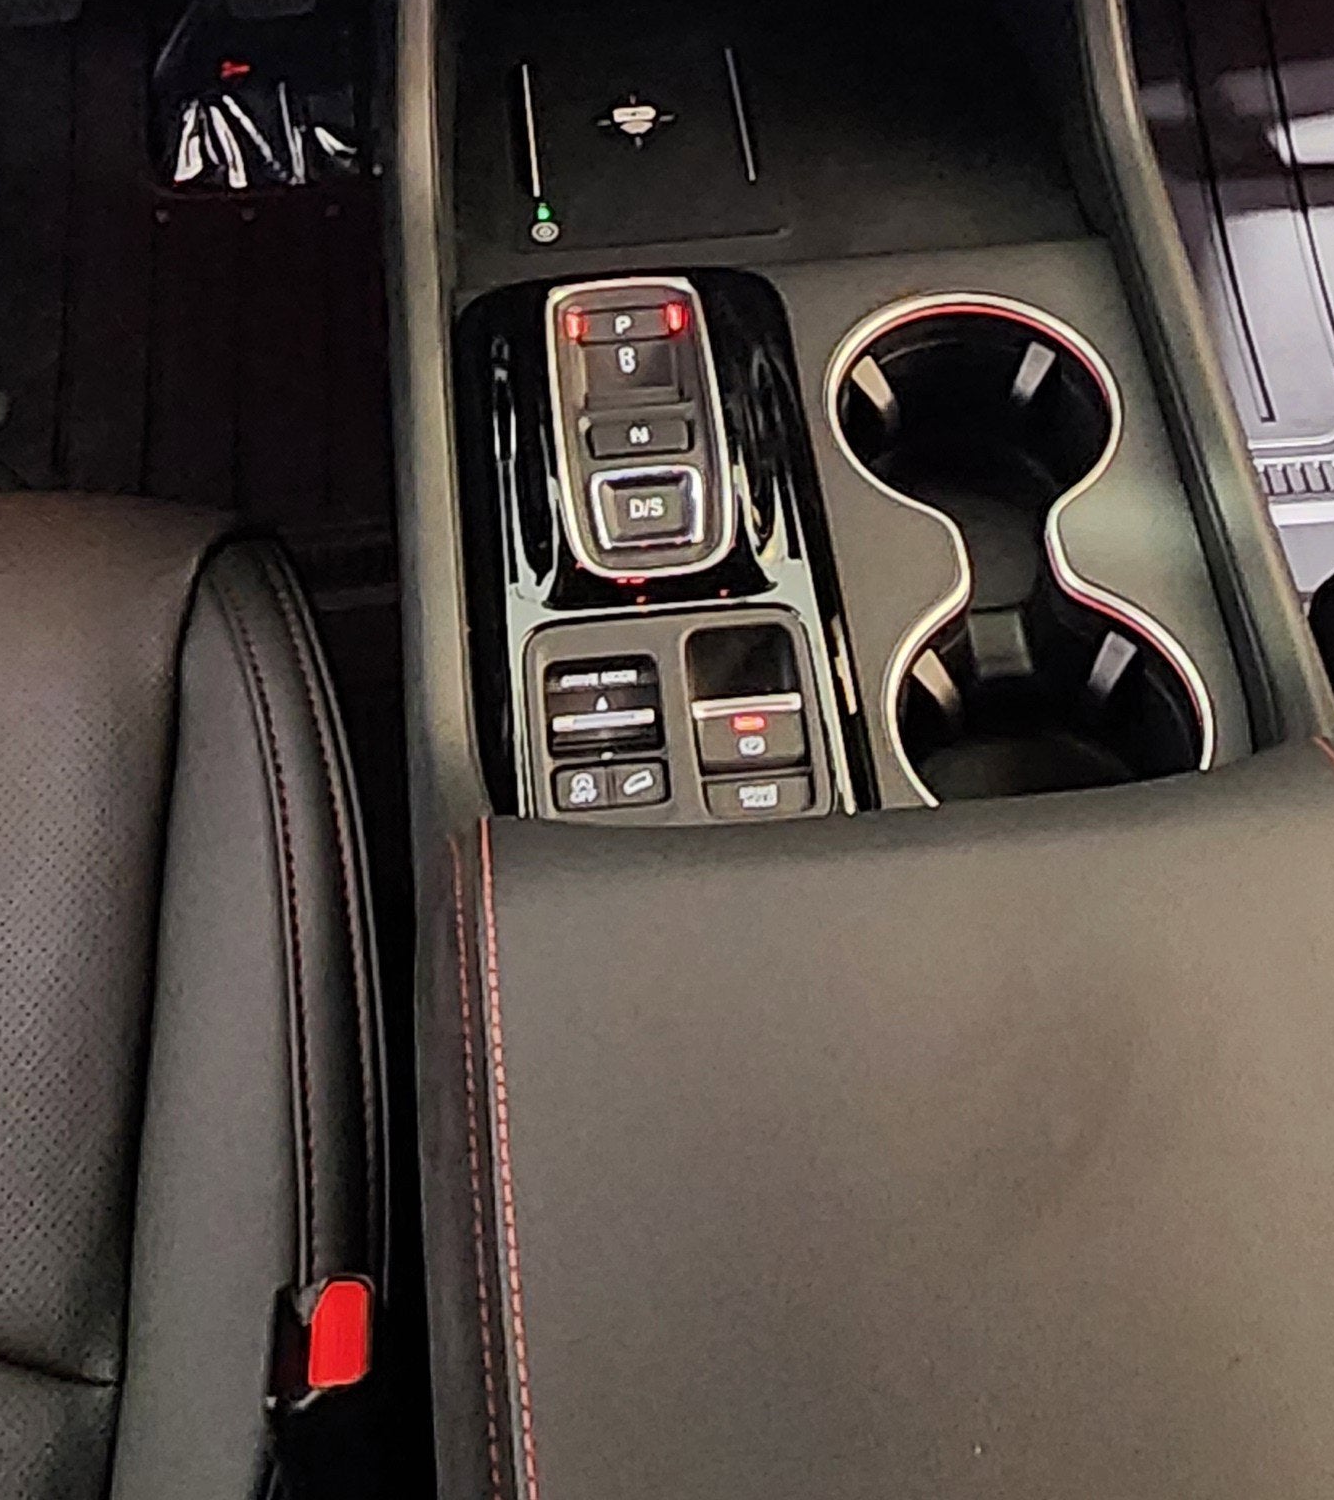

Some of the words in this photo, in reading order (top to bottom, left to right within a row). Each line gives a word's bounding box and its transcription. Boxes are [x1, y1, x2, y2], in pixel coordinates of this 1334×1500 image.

[615, 313, 632, 335] P
[628, 425, 649, 445] N
[628, 498, 665, 520] D/S
